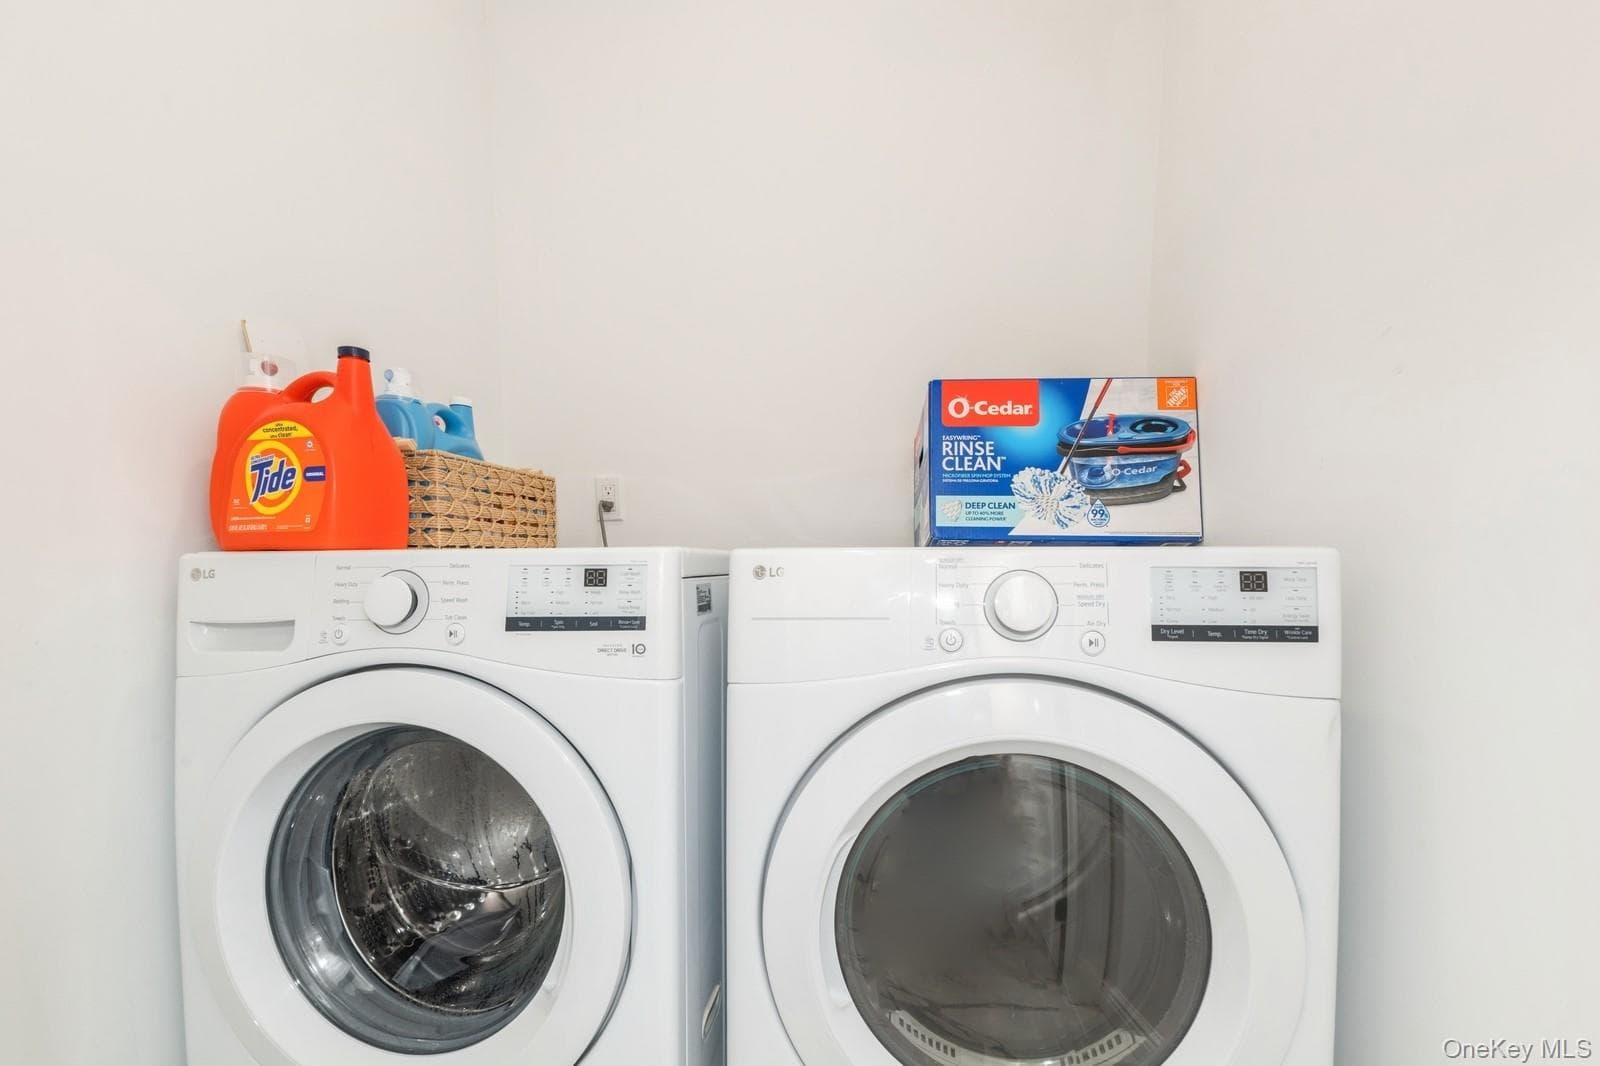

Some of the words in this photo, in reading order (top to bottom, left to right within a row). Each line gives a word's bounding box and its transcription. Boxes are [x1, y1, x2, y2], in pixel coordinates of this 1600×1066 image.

[948, 396, 1032, 418] O-Cedar
[942, 441, 994, 456] RINSE
[1112, 466, 1157, 476] O-Cedar
[250, 458, 297, 504] Tide
